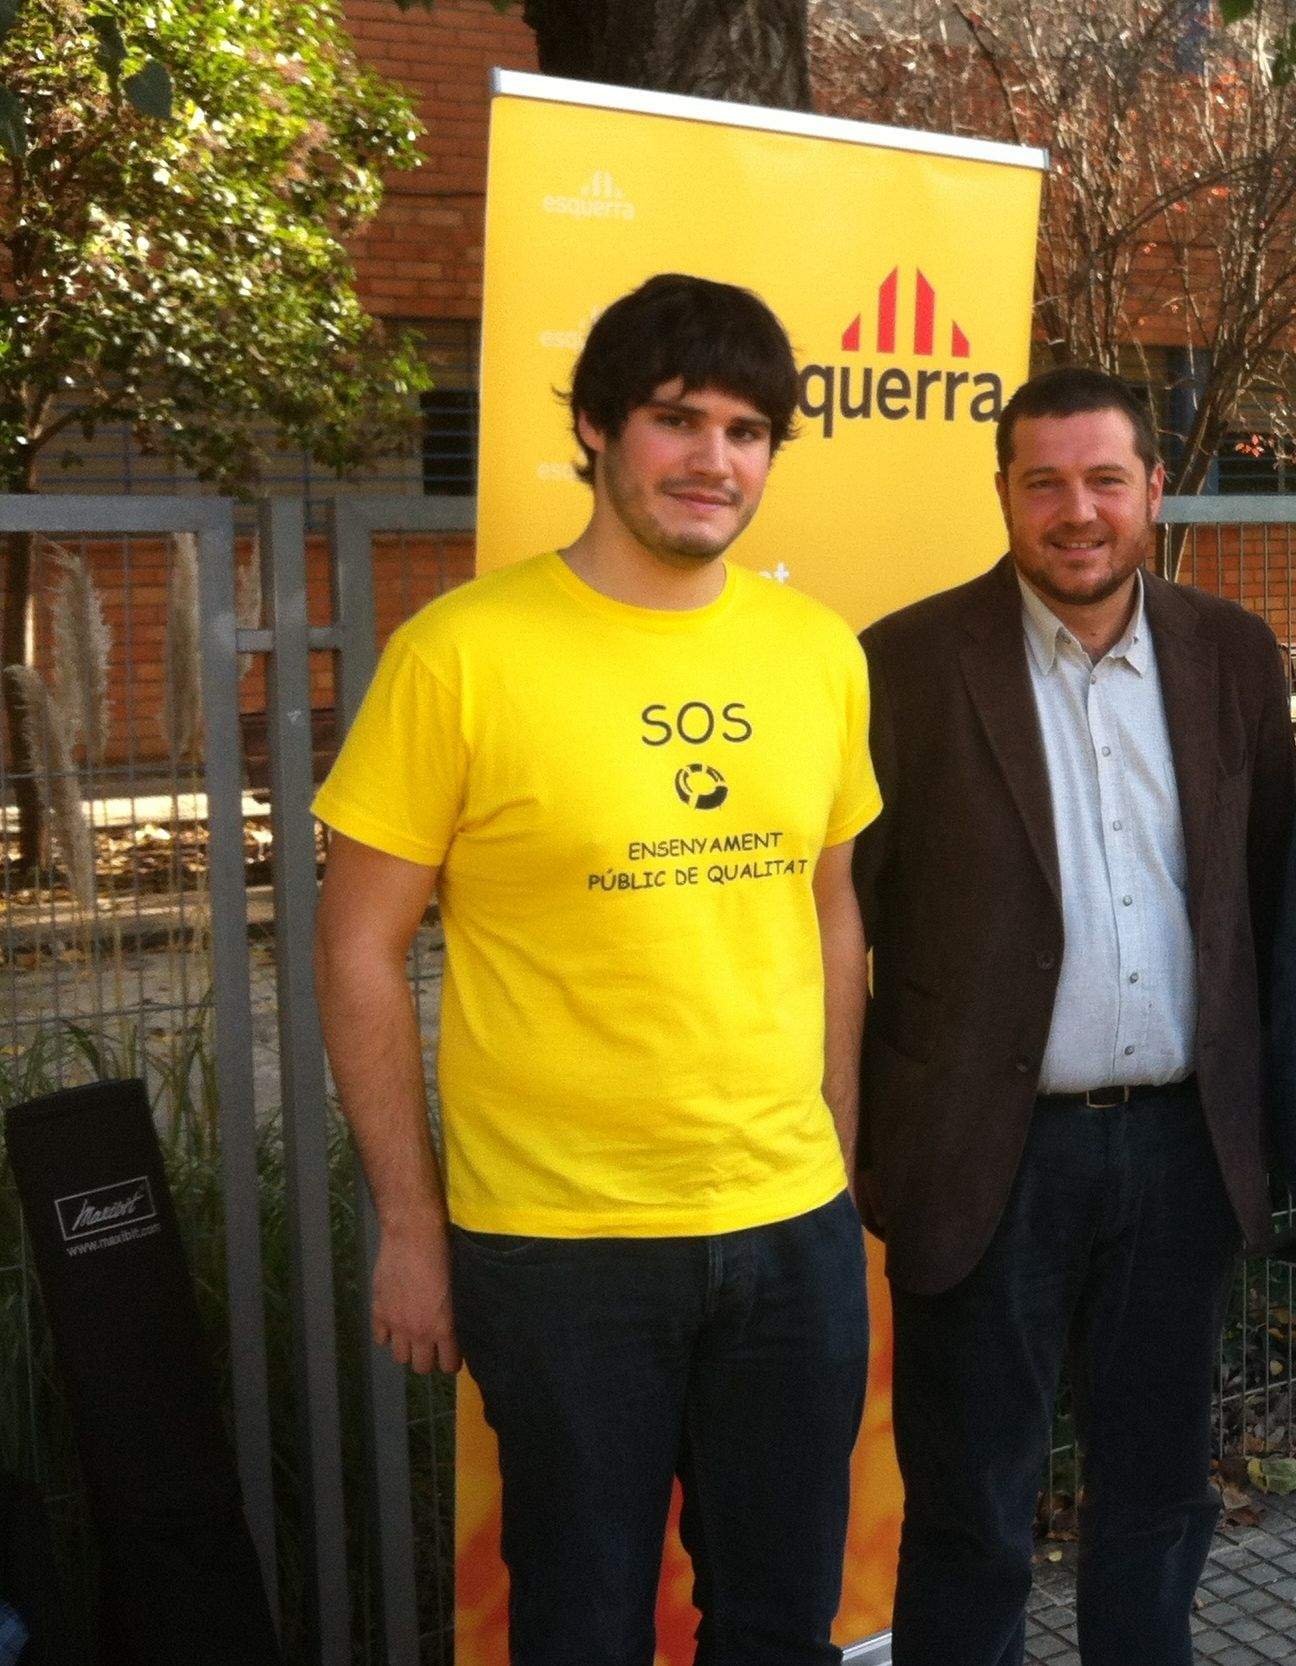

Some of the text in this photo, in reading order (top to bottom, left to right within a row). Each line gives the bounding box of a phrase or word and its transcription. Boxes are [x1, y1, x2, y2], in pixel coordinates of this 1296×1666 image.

[799, 363, 1003, 439] querra
[641, 701, 753, 747] SOS
[628, 831, 783, 860] ENSENYAMENT
[587, 859, 808, 891] PÚBLIC DE QUALITAT
